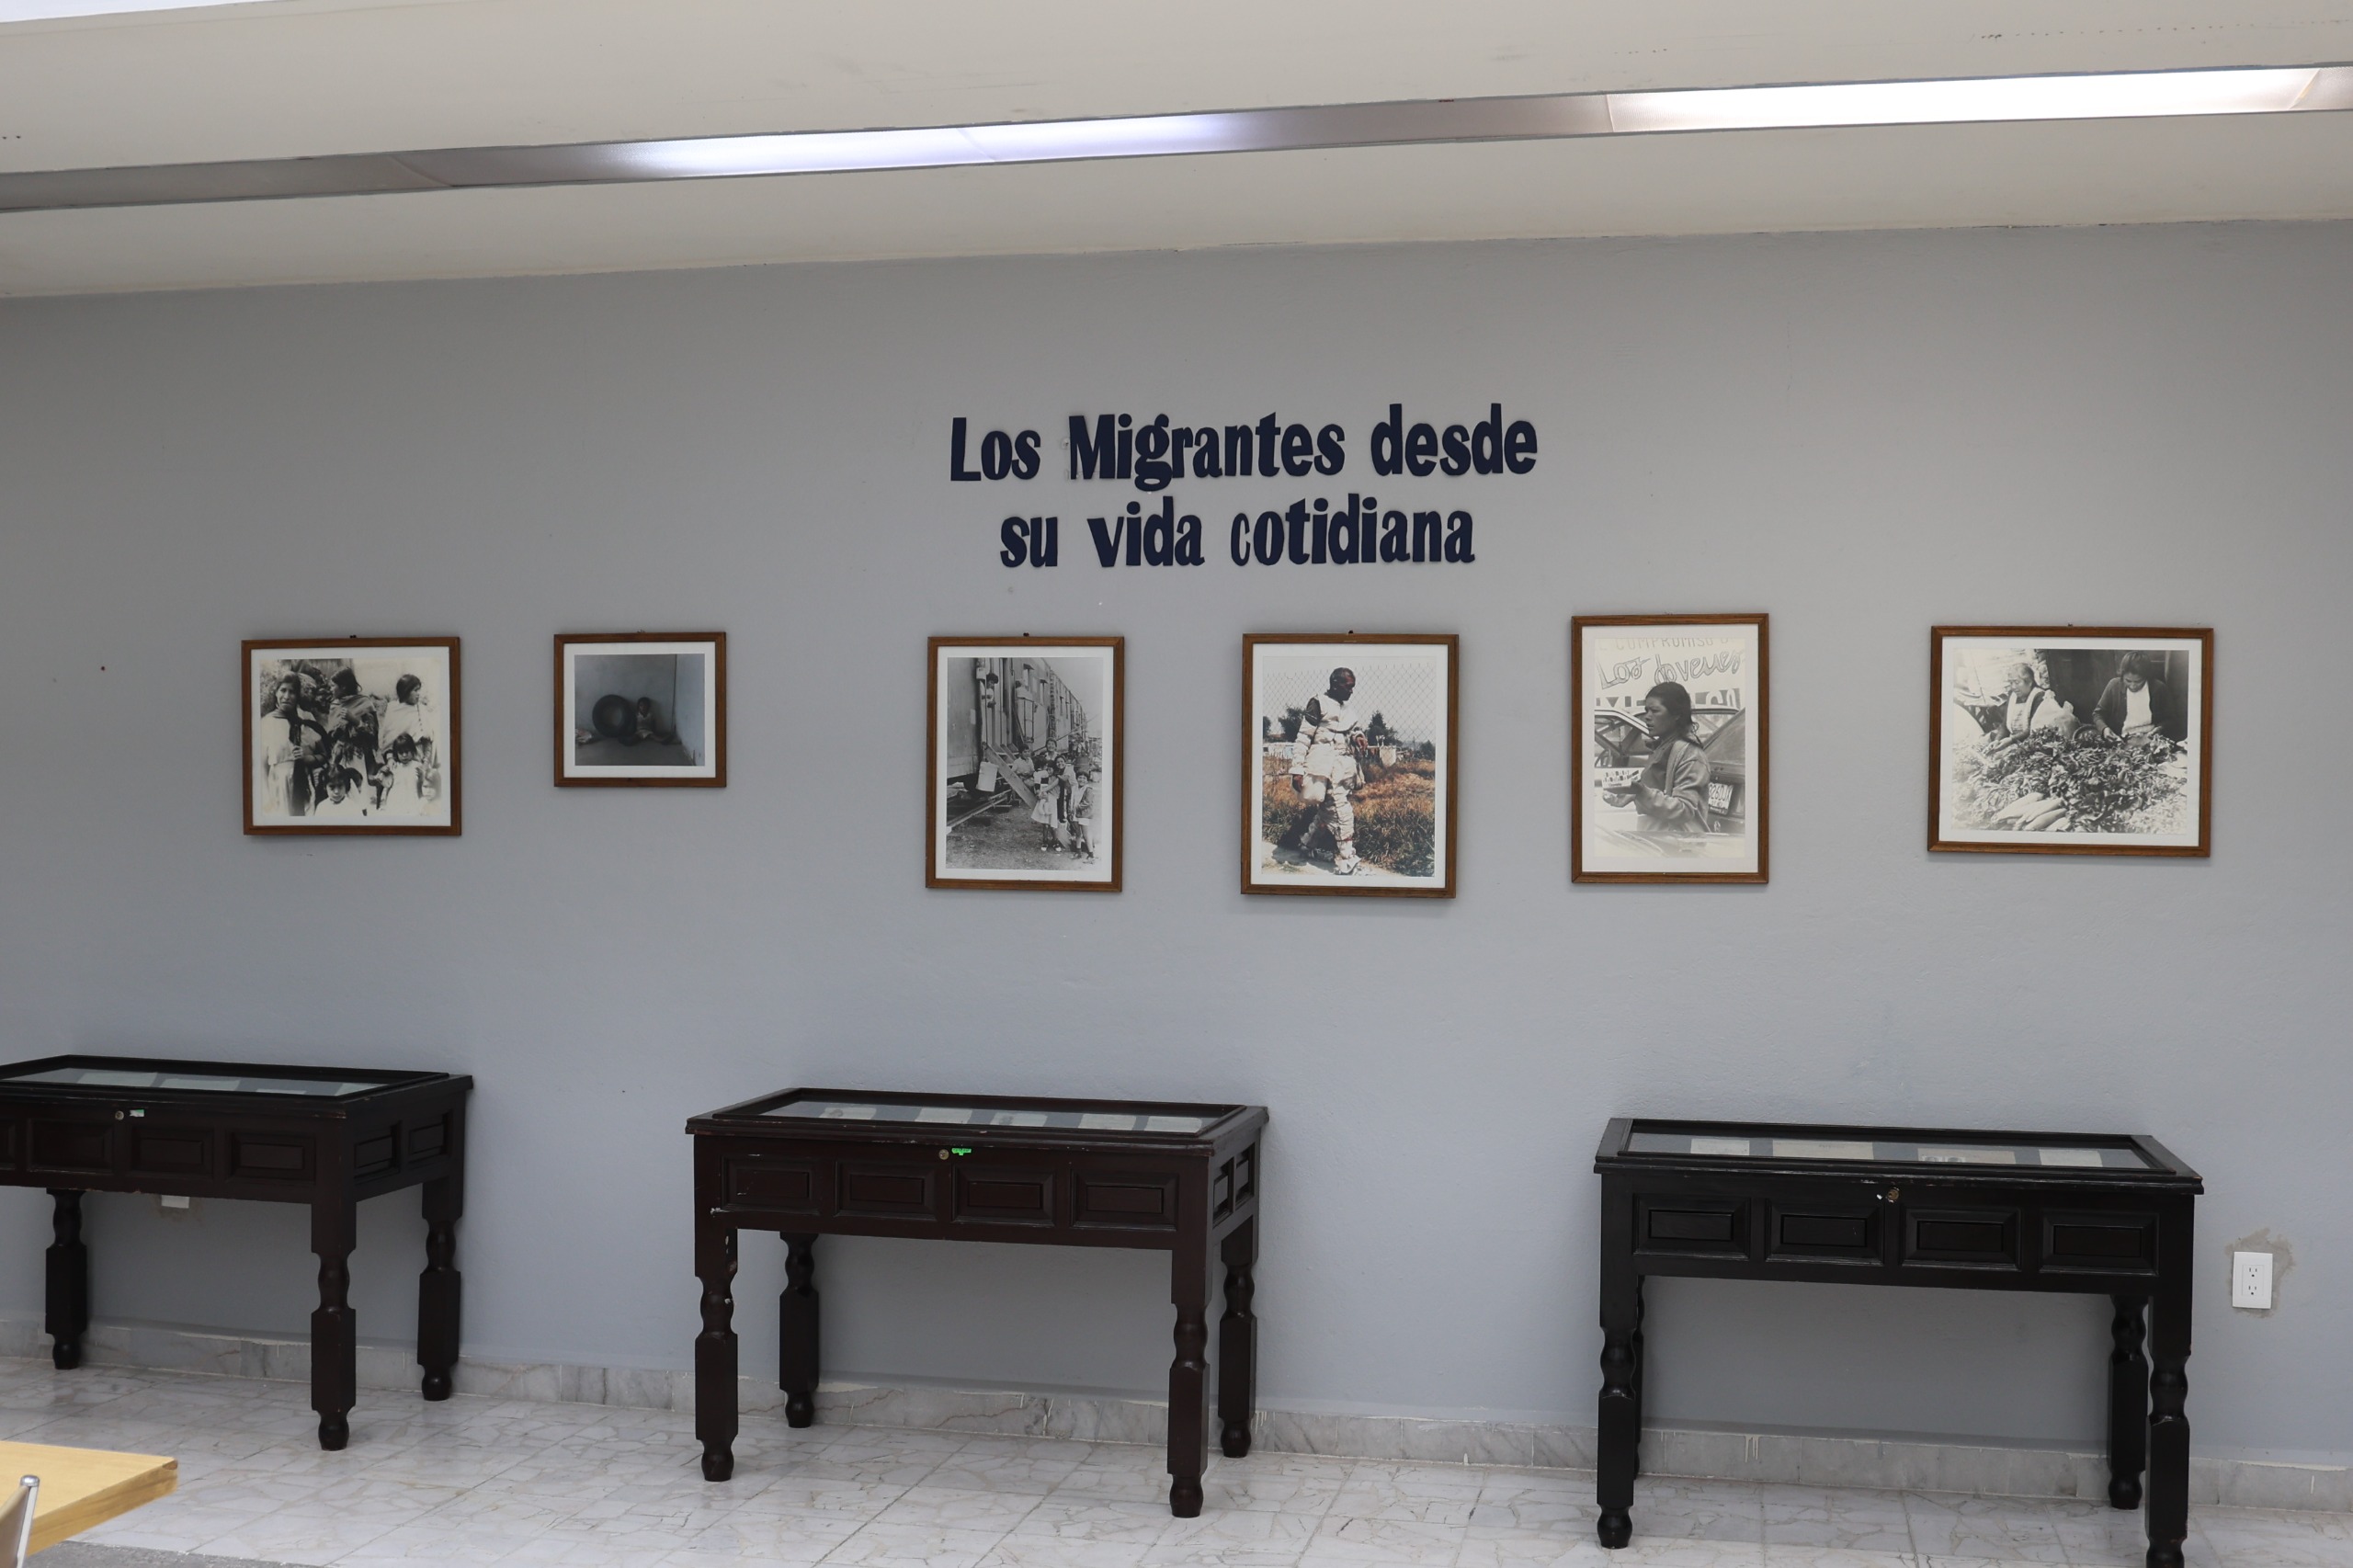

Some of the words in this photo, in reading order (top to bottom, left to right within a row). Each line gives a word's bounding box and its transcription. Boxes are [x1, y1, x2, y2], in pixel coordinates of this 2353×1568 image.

[950, 417, 1041, 482] Los
[1069, 412, 1346, 492] Migrantes
[1370, 403, 1539, 477] desde
[1000, 516, 1059, 568] su
[1086, 495, 1205, 568] vida
[1231, 493, 1476, 567] cotidiana
